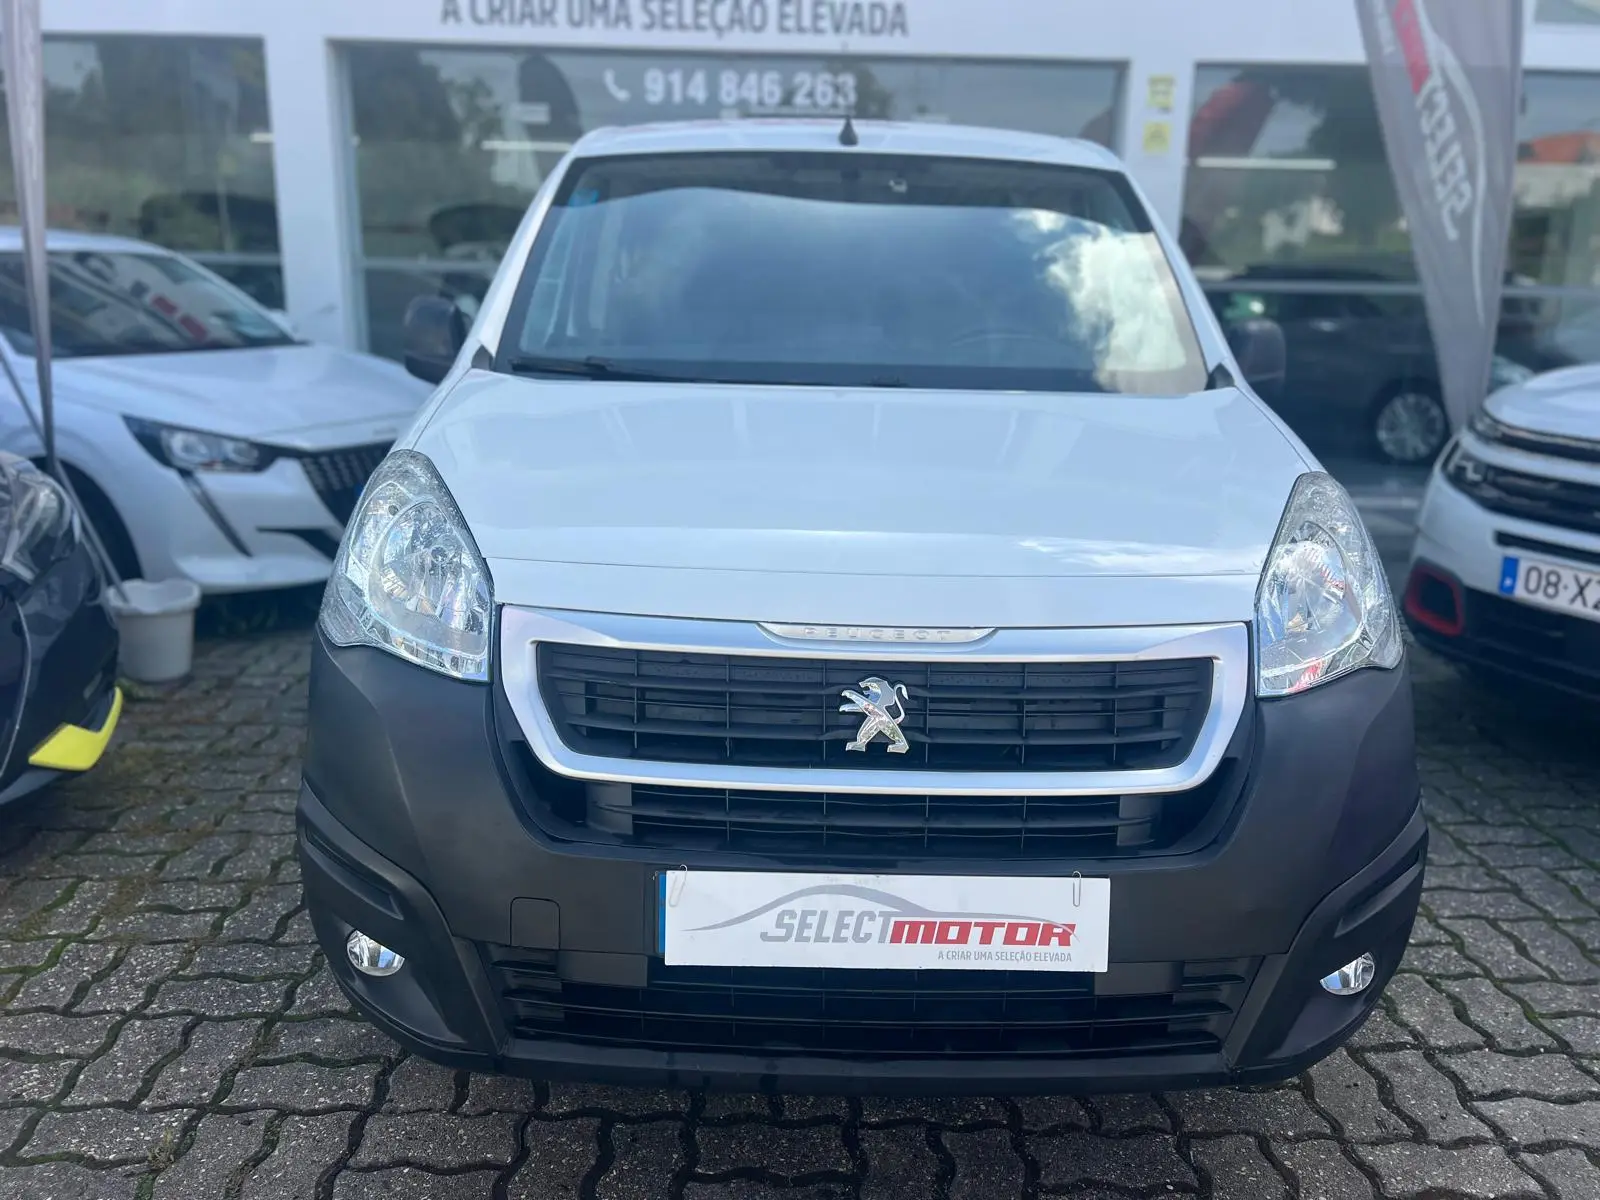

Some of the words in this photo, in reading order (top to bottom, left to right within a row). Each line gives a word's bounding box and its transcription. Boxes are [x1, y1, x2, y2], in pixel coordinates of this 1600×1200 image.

[441, 0, 462, 25] A
[470, 0, 559, 28] CRIAR
[566, 0, 632, 30] UMA
[777, 0, 909, 37] ELEVADA
[644, 68, 709, 106] 914
[718, 69, 782, 106] 846
[792, 71, 857, 108] 263
[802, 626, 951, 641] PEUGEOT
[938, 950, 944, 960] A
[946, 950, 971, 961] CRIAR
[973, 951, 993, 961] UMA
[995, 950, 1032, 963] SELEÇÃO
[1034, 952, 1073, 963] ELEVADA
